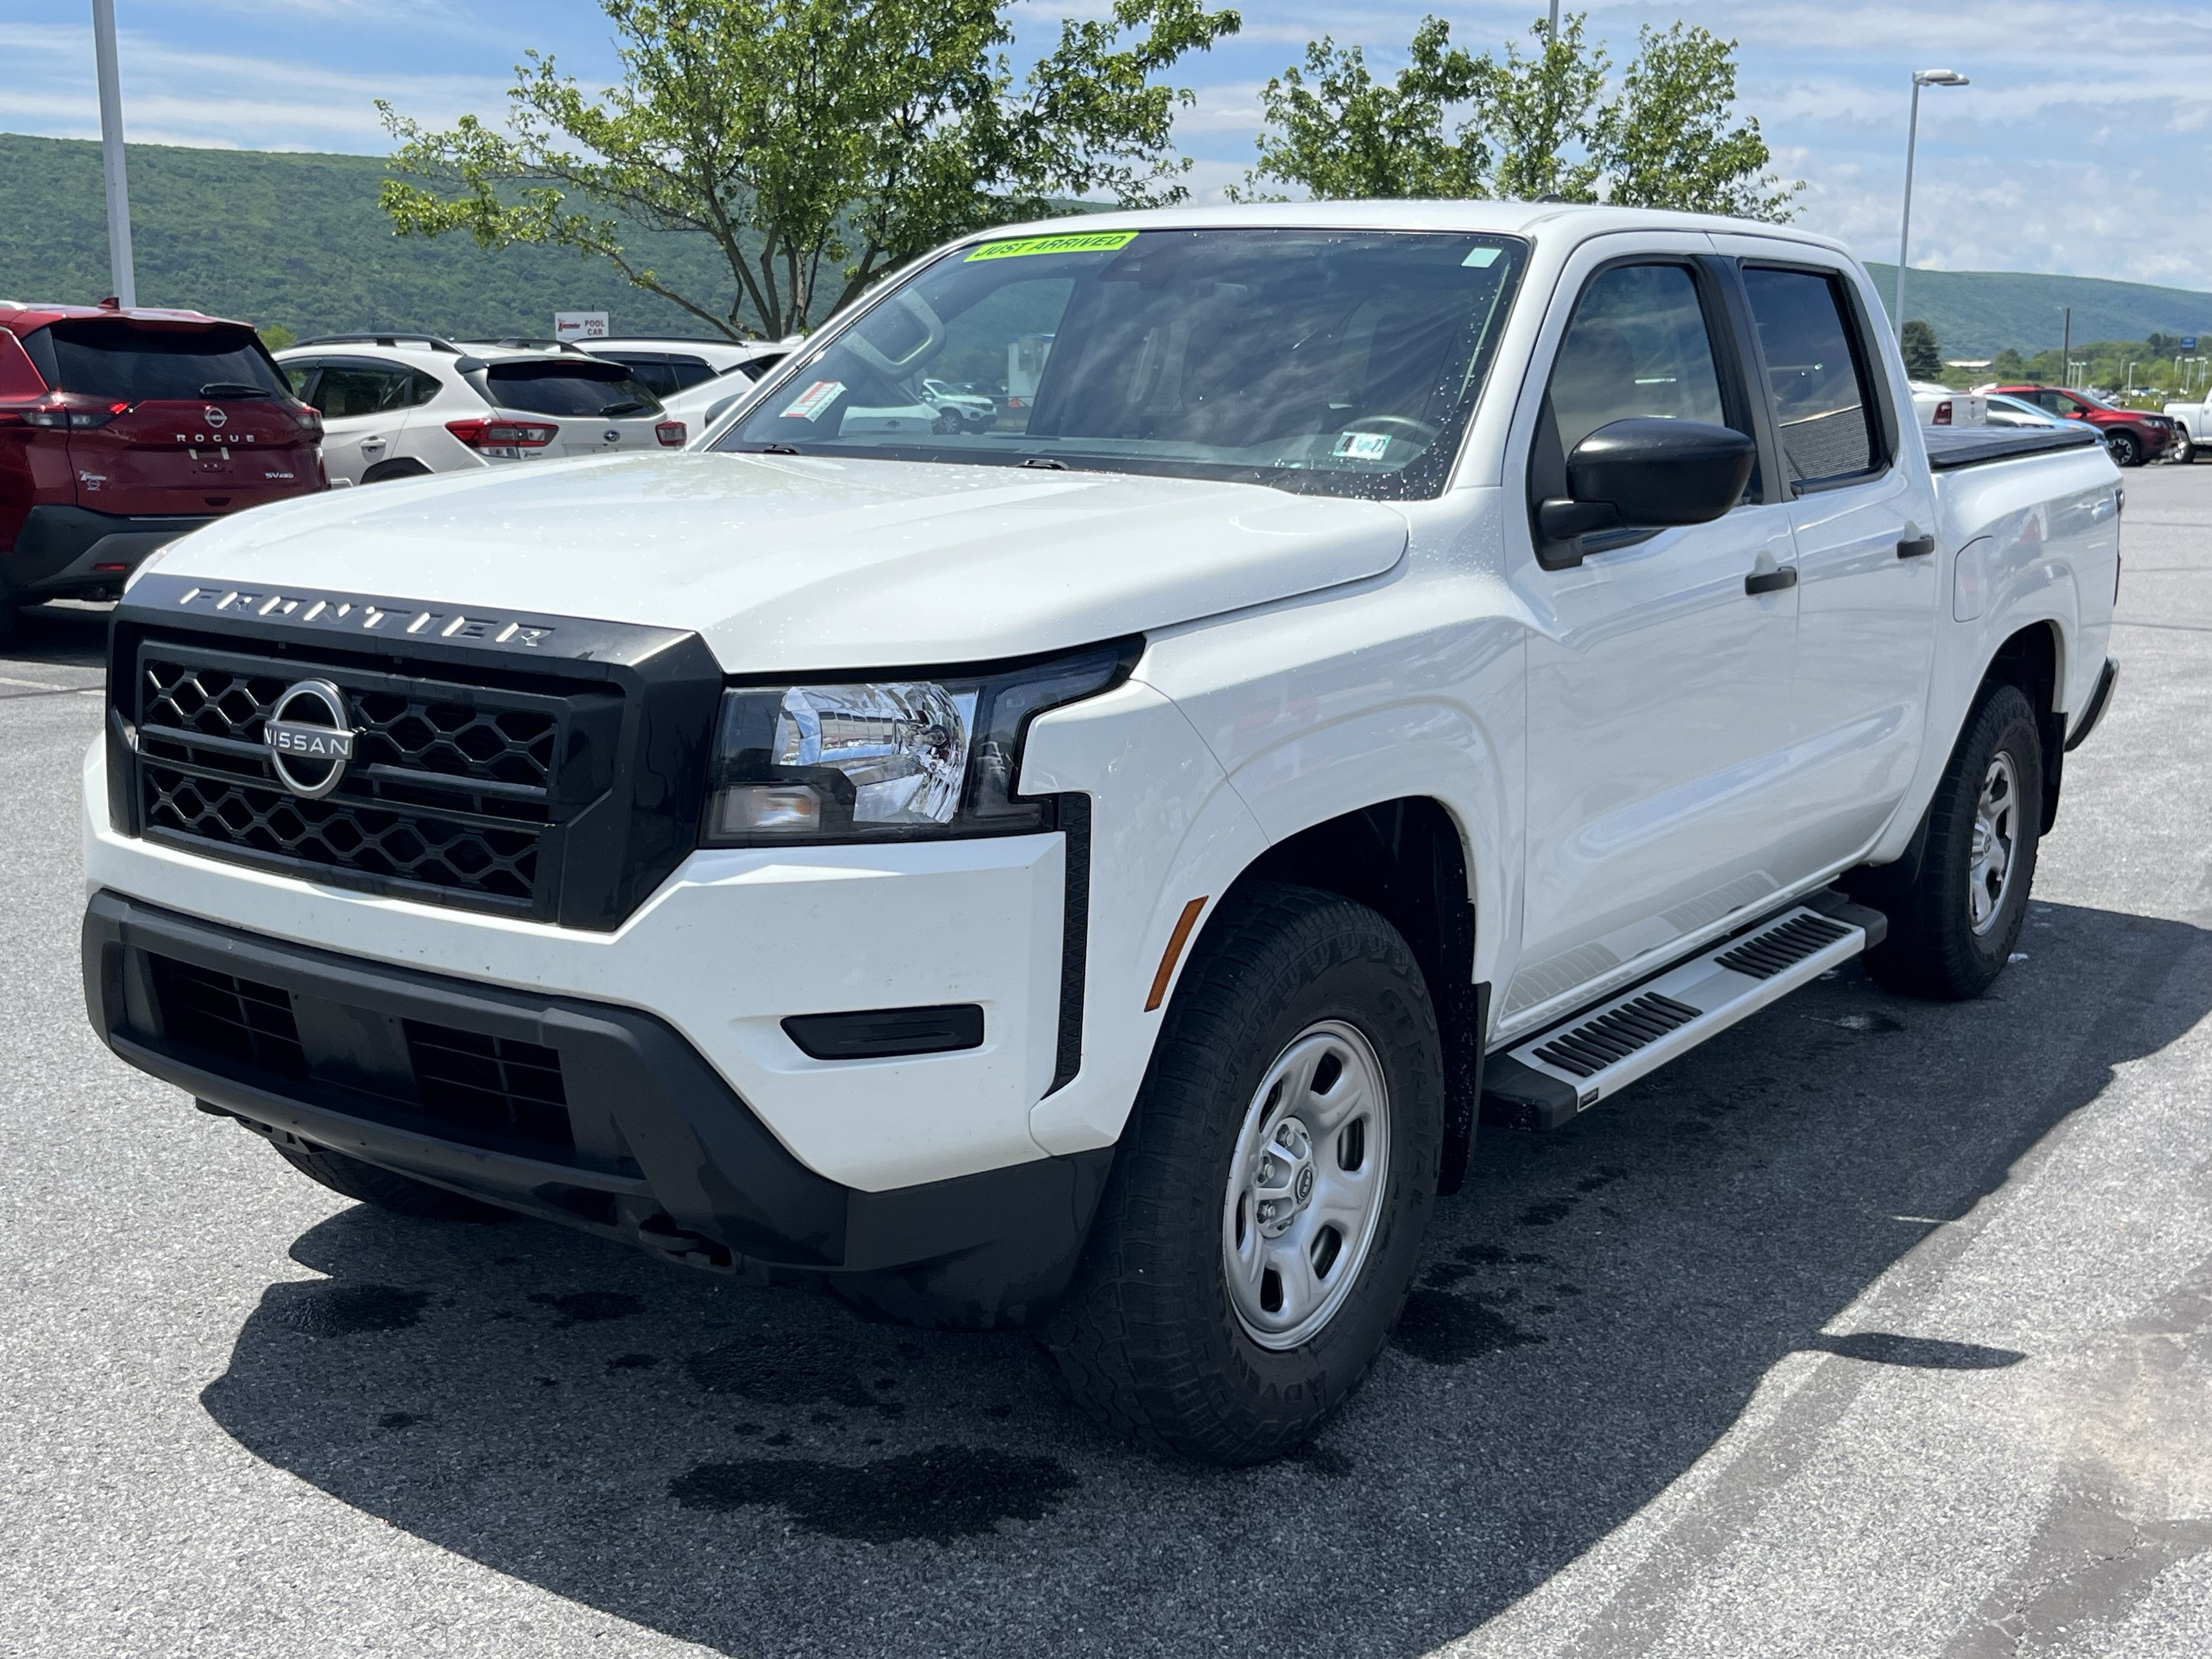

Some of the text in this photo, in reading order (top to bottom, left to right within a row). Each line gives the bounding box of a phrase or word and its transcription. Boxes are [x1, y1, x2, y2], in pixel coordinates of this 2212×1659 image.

[974, 235, 1127, 257] JUST ARRIVED
[176, 434, 255, 442] ROGUE
[179, 588, 556, 647] FRONTIER
[264, 726, 349, 755] NISSAN
